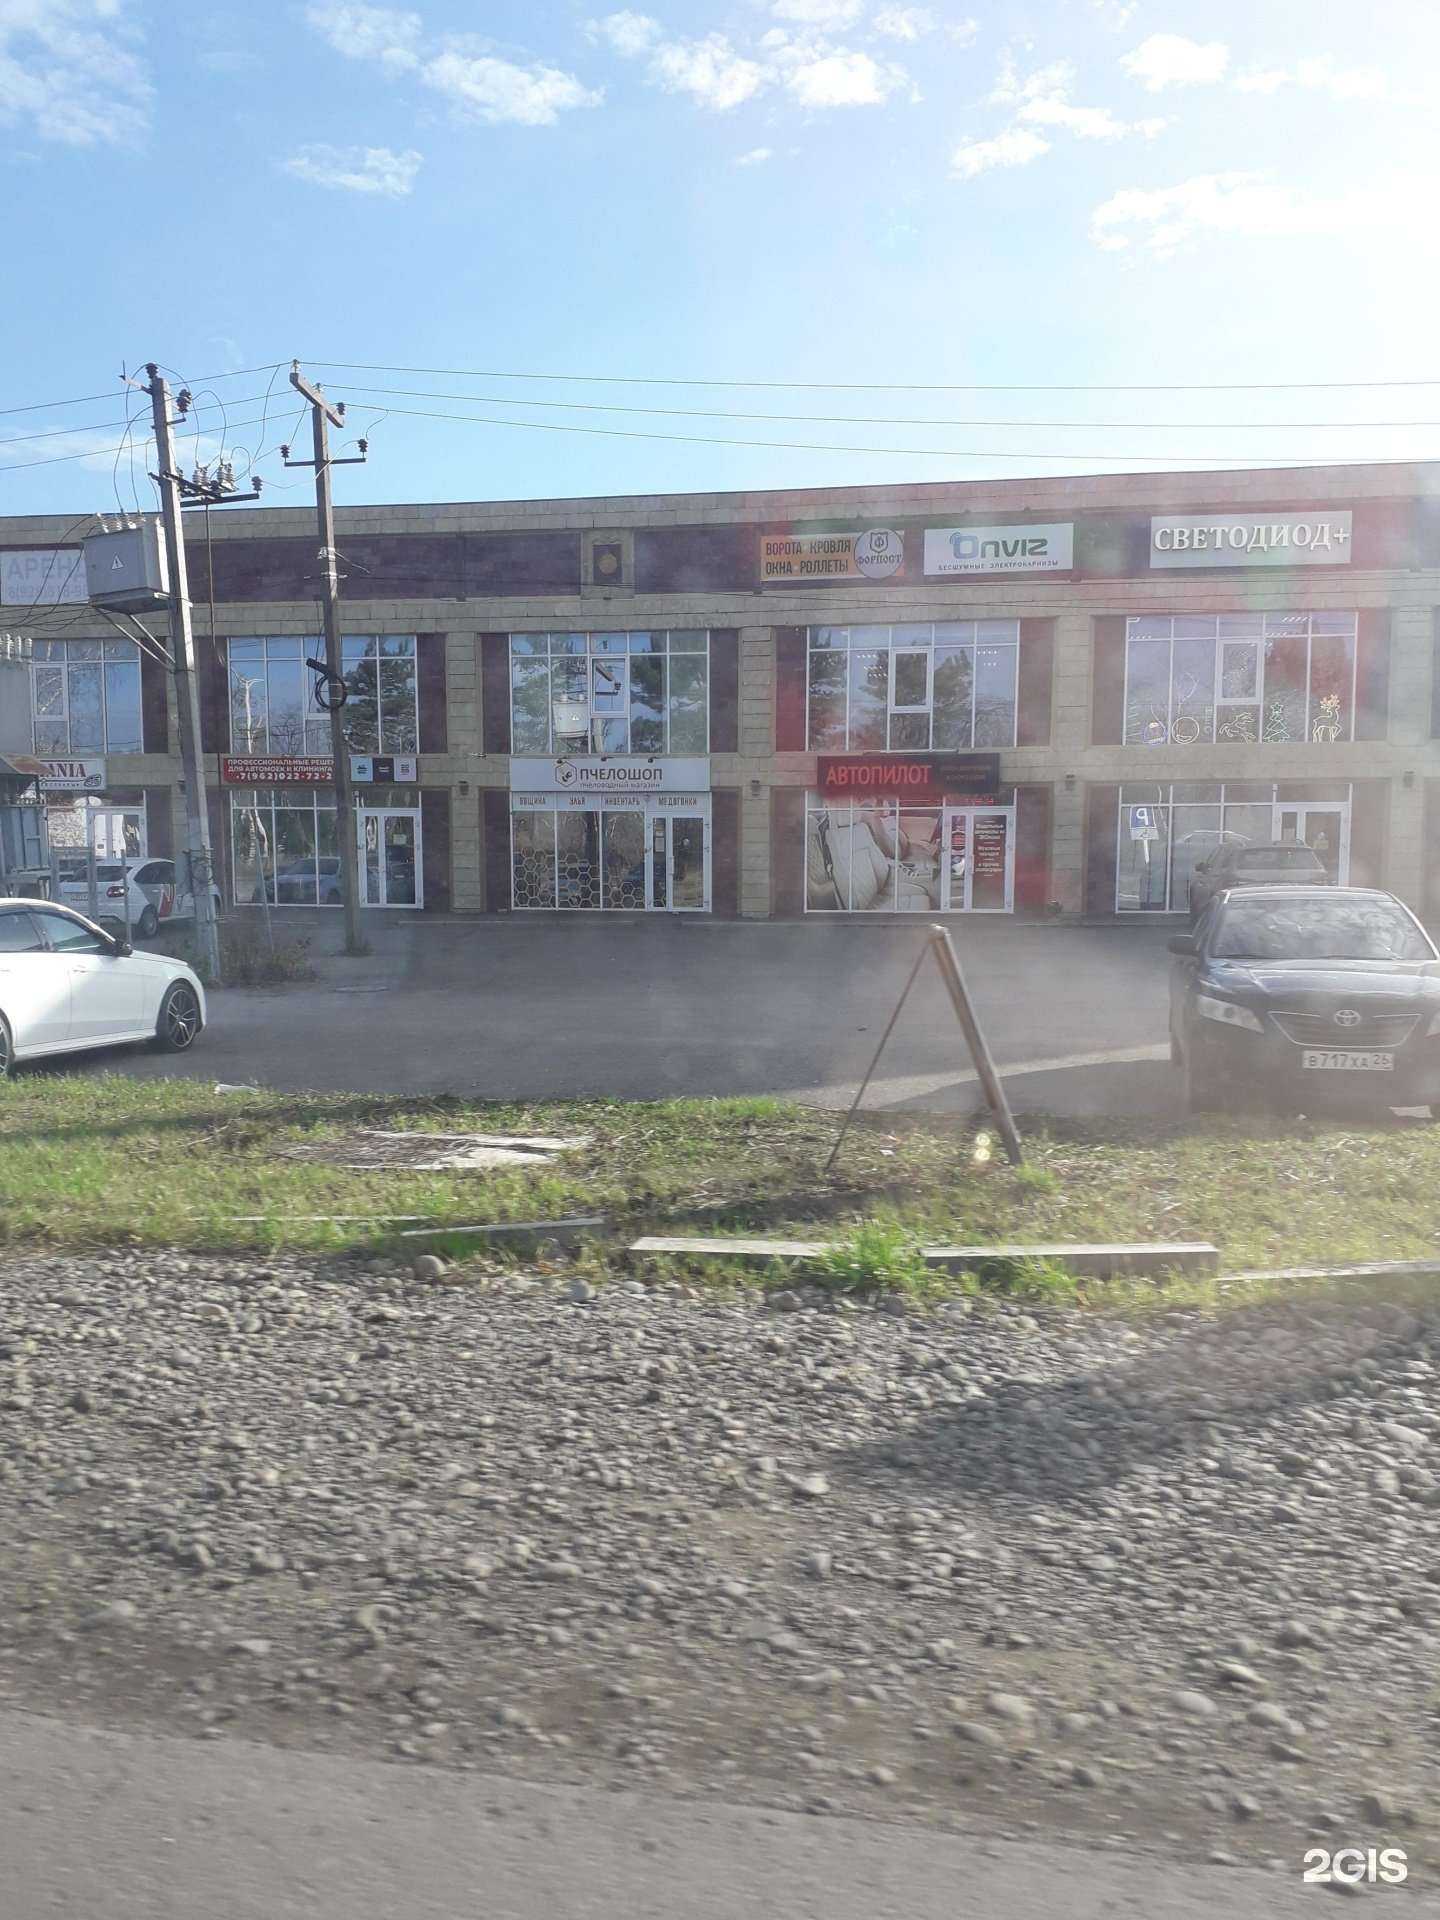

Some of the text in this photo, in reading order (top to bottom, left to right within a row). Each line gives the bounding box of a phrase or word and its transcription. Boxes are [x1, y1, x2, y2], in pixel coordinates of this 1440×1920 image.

[1155, 523, 1350, 553] СВЕТОДИОД+
[766, 539, 850, 556] ВОРОТА КРОВЛЯ
[766, 560, 848, 575] ОКНА РОЛЛЕТЫ
[858, 554, 902, 565] ФОРПОСТ
[580, 768, 663, 781] ПЧЕЛОШОП
[826, 765, 931, 785] АВТОПИЛОТ
